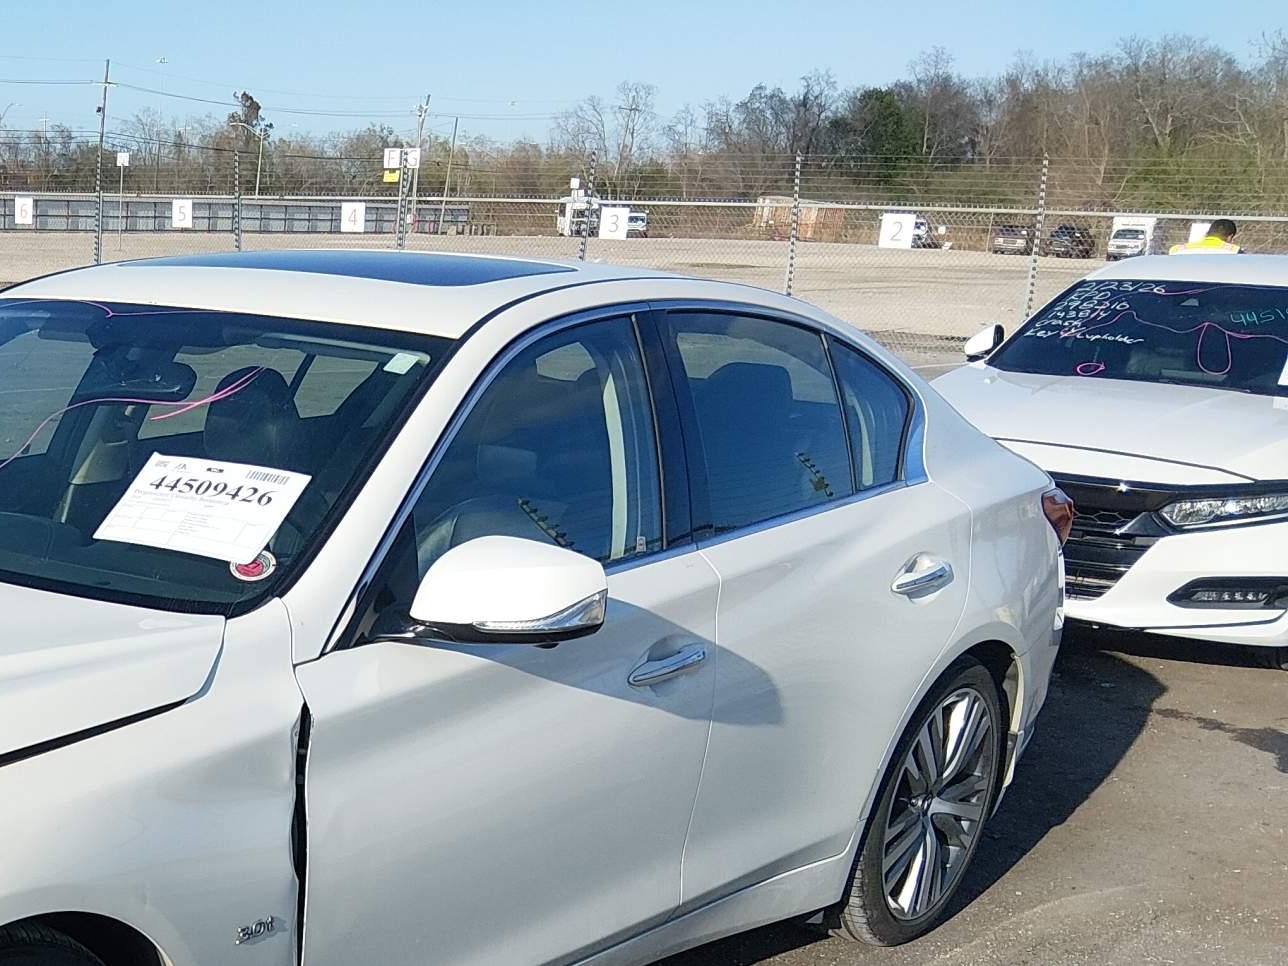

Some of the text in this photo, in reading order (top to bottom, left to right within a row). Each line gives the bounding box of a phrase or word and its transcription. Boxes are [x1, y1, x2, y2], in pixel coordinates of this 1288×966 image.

[20, 203, 29, 219] 6
[178, 205, 186, 221] 5
[348, 208, 358, 225] 4
[608, 214, 619, 233] 3
[890, 221, 903, 241] 2
[149, 474, 279, 507] 44509426
